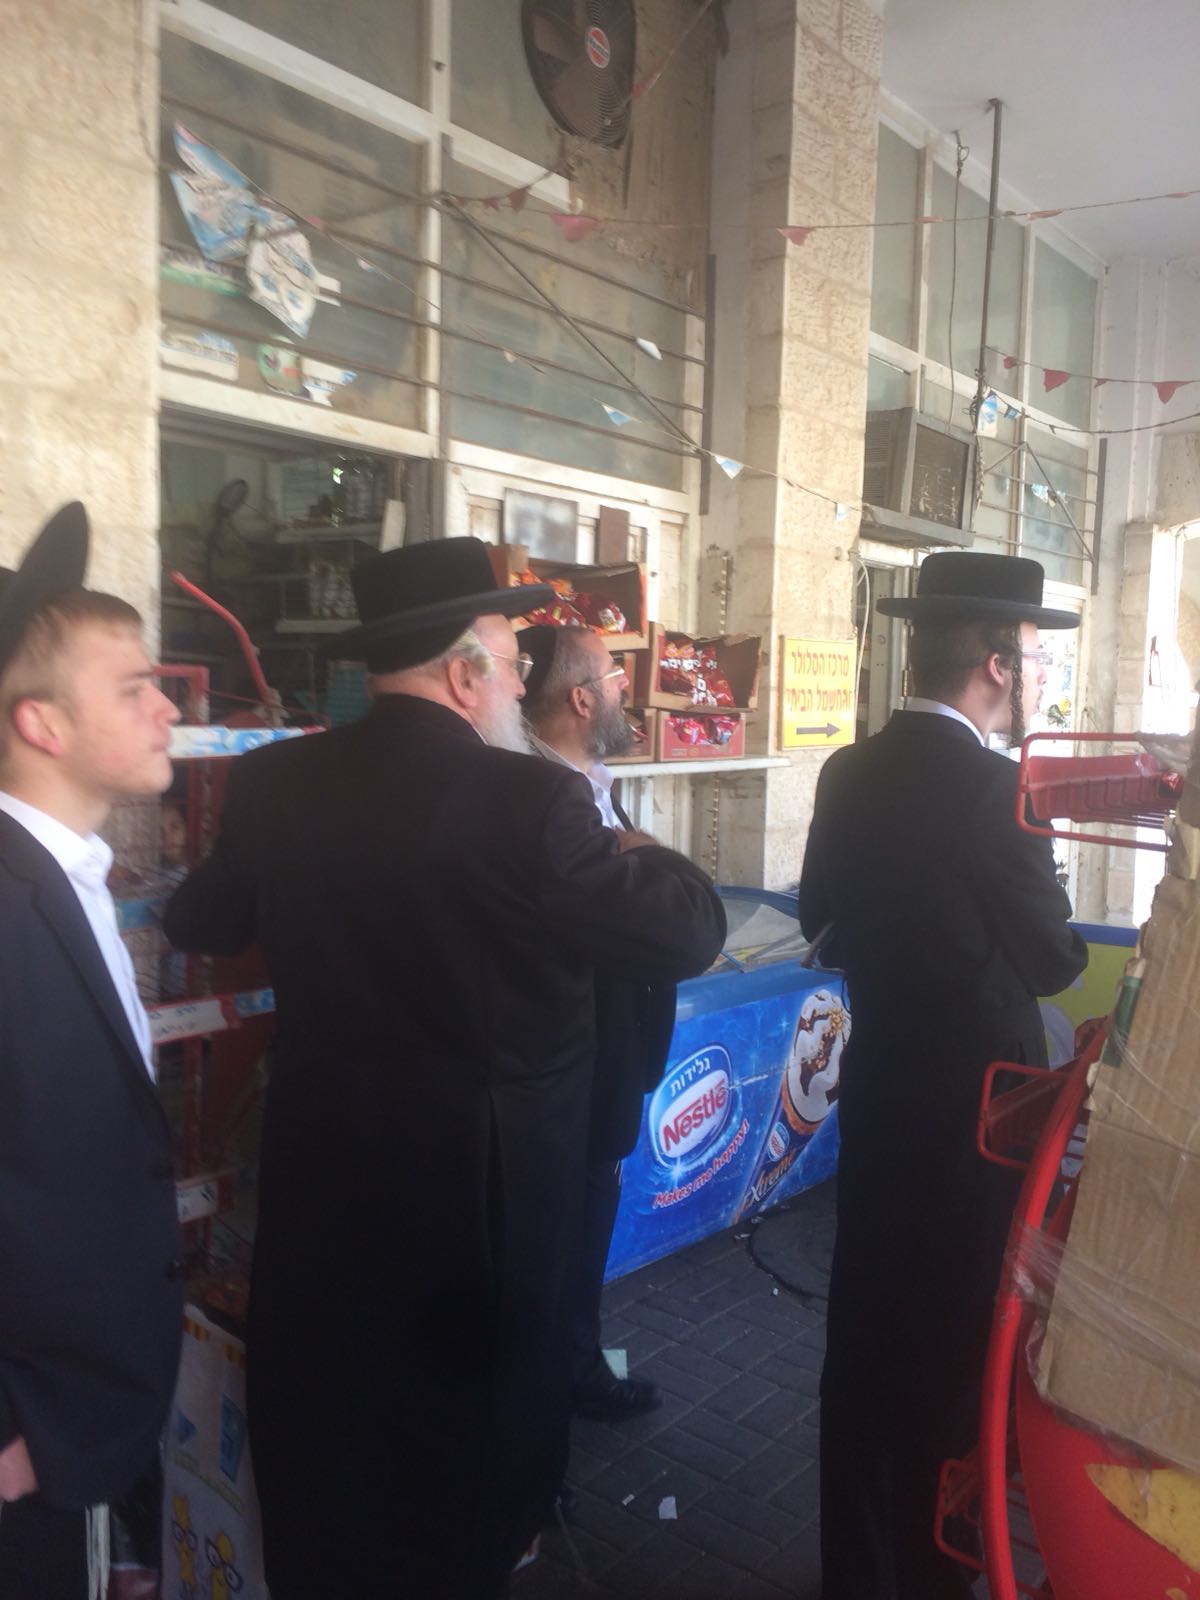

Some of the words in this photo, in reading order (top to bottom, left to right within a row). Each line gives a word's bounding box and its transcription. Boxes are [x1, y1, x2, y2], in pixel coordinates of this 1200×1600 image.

[791, 647, 826, 677] הסלולר
[828, 652, 850, 677] מרכז
[670, 1057, 711, 1098] גלידות
[662, 1077, 728, 1152] Nestlé
[652, 1183, 693, 1209] Makes
[692, 1167, 714, 1192] me
